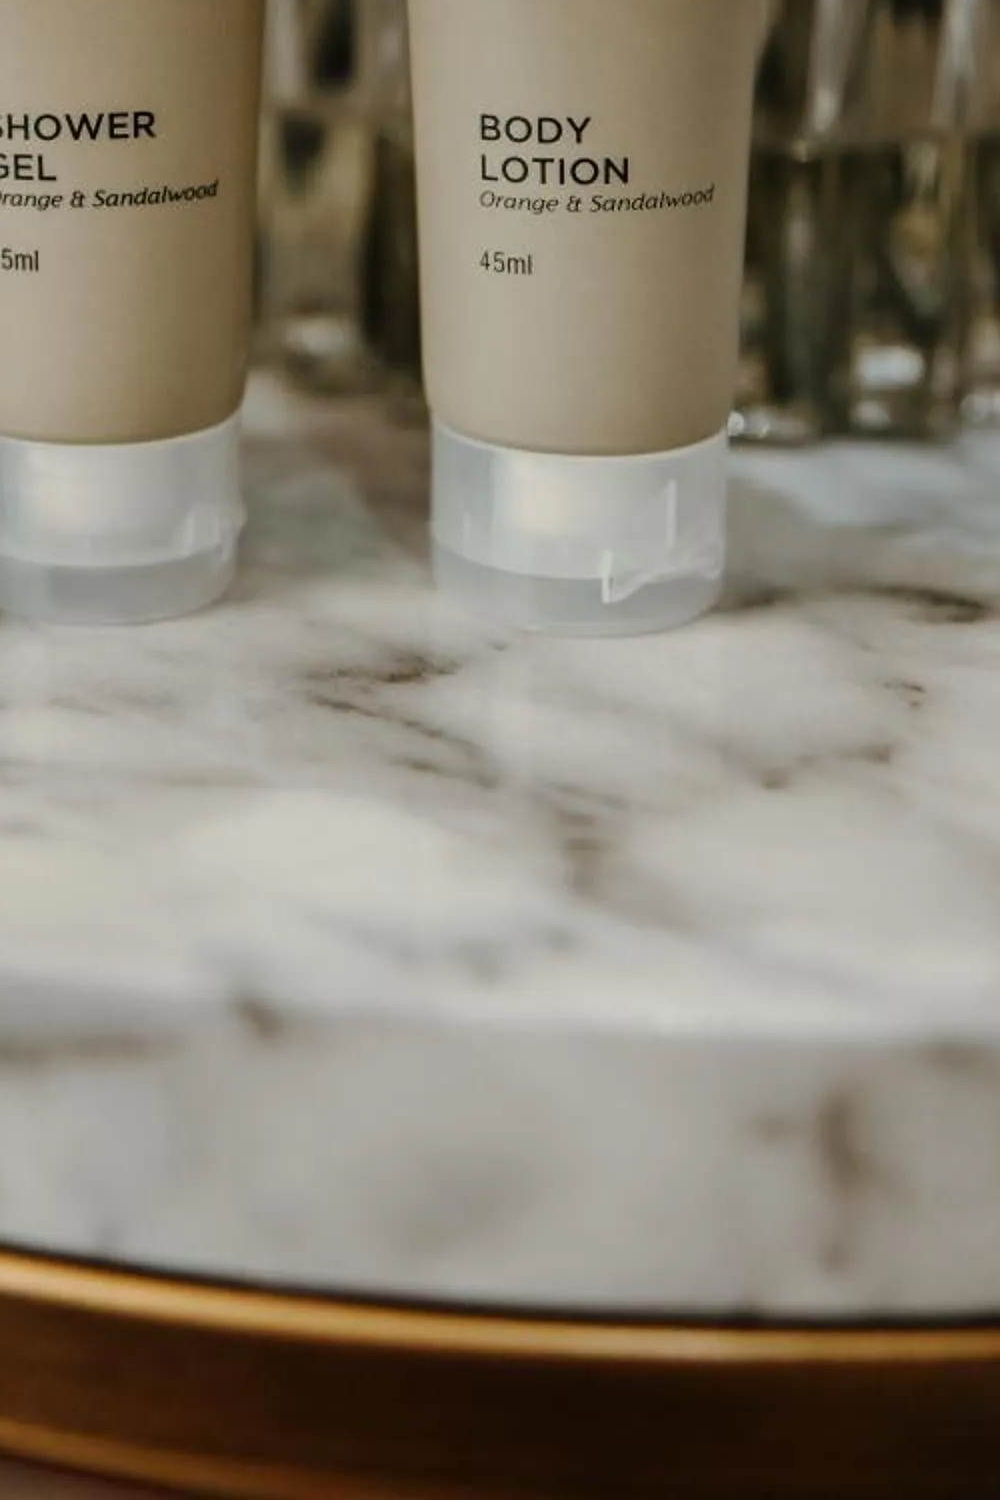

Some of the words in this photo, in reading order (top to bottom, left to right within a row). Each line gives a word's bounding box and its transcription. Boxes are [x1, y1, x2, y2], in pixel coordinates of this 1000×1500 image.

[480, 114, 591, 144] BODY
[481, 154, 629, 185] LOTION
[70, 189, 85, 208] &
[92, 180, 219, 207] Sandalwood
[480, 190, 559, 215] Orange
[566, 192, 582, 212] &
[590, 184, 714, 212] Sandalwood
[480, 251, 532, 275] 45ml
